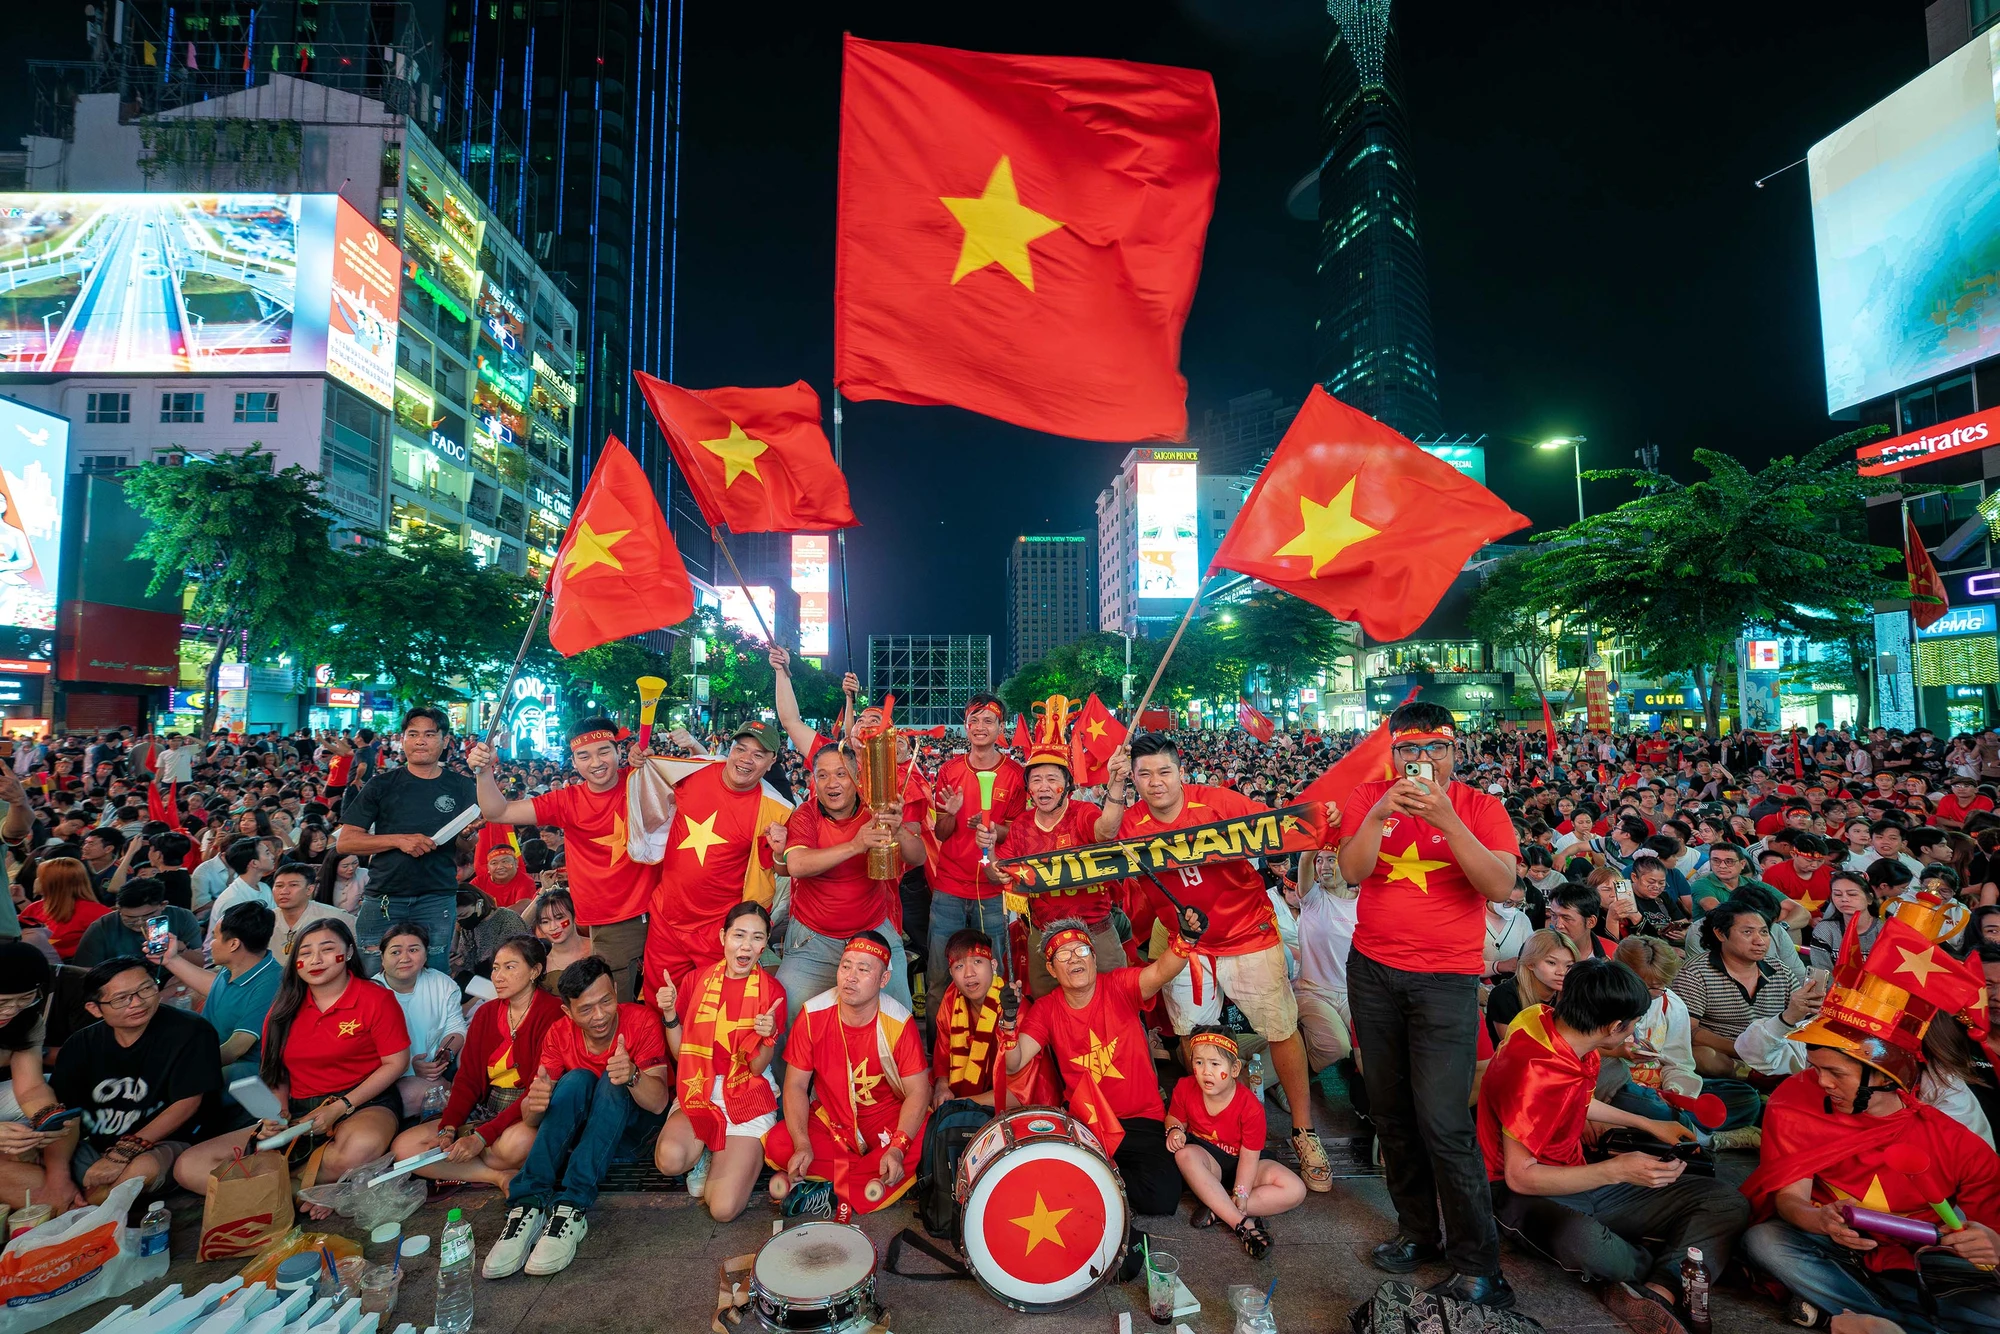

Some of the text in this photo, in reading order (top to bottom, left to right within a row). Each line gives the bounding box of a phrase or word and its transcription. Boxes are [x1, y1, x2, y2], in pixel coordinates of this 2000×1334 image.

[431, 430, 465, 461] FADO
[1154, 452, 1198, 460] SAIGON PRINCE
[1881, 423, 1989, 466] Emirates
[535, 488, 553, 509] THE
[553, 499, 571, 519] ONE
[1926, 617, 1982, 634] KPMG
[1645, 694, 1684, 705] GUTA
[1027, 815, 1281, 887] VIETNAM
[1178, 866, 1203, 888] 19
